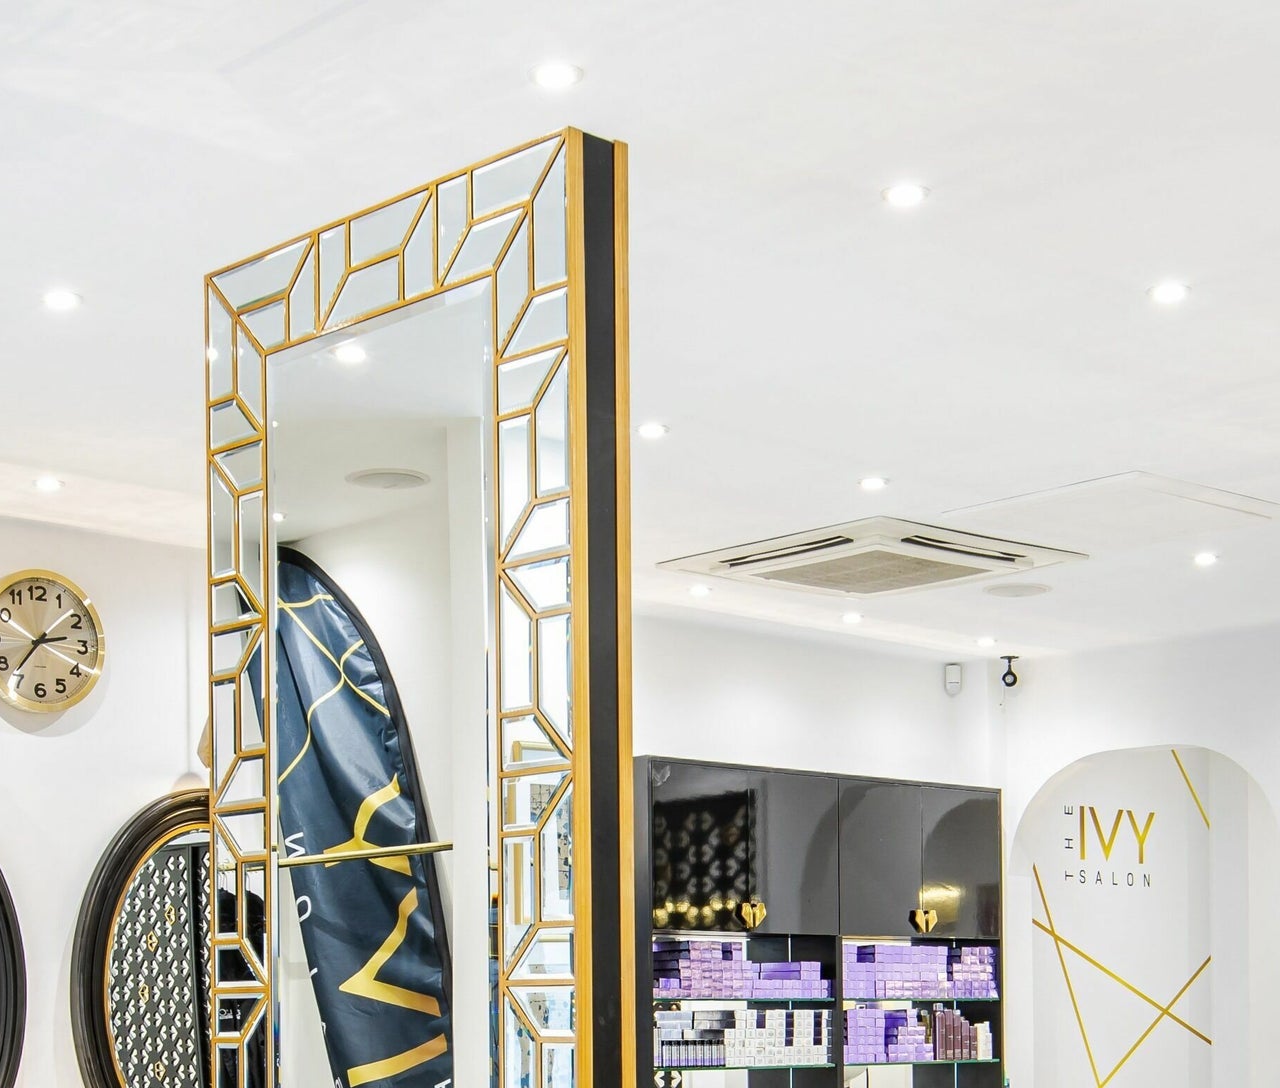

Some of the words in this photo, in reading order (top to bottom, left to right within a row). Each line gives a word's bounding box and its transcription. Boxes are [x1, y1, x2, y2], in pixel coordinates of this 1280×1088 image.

[9, 589, 22, 605] 11
[27, 585, 48, 602] 12
[55, 593, 62, 609] 1
[70, 613, 82, 629] 2
[76, 640, 88, 655] 3
[70, 662, 82, 678] 4
[13, 673, 25, 689] 7
[55, 678, 67, 694] 5
[34, 683, 47, 698] 6
[1064, 804, 1074, 881] THE
[1079, 805, 1156, 865] IVY
[1079, 869, 1151, 887] SALON
